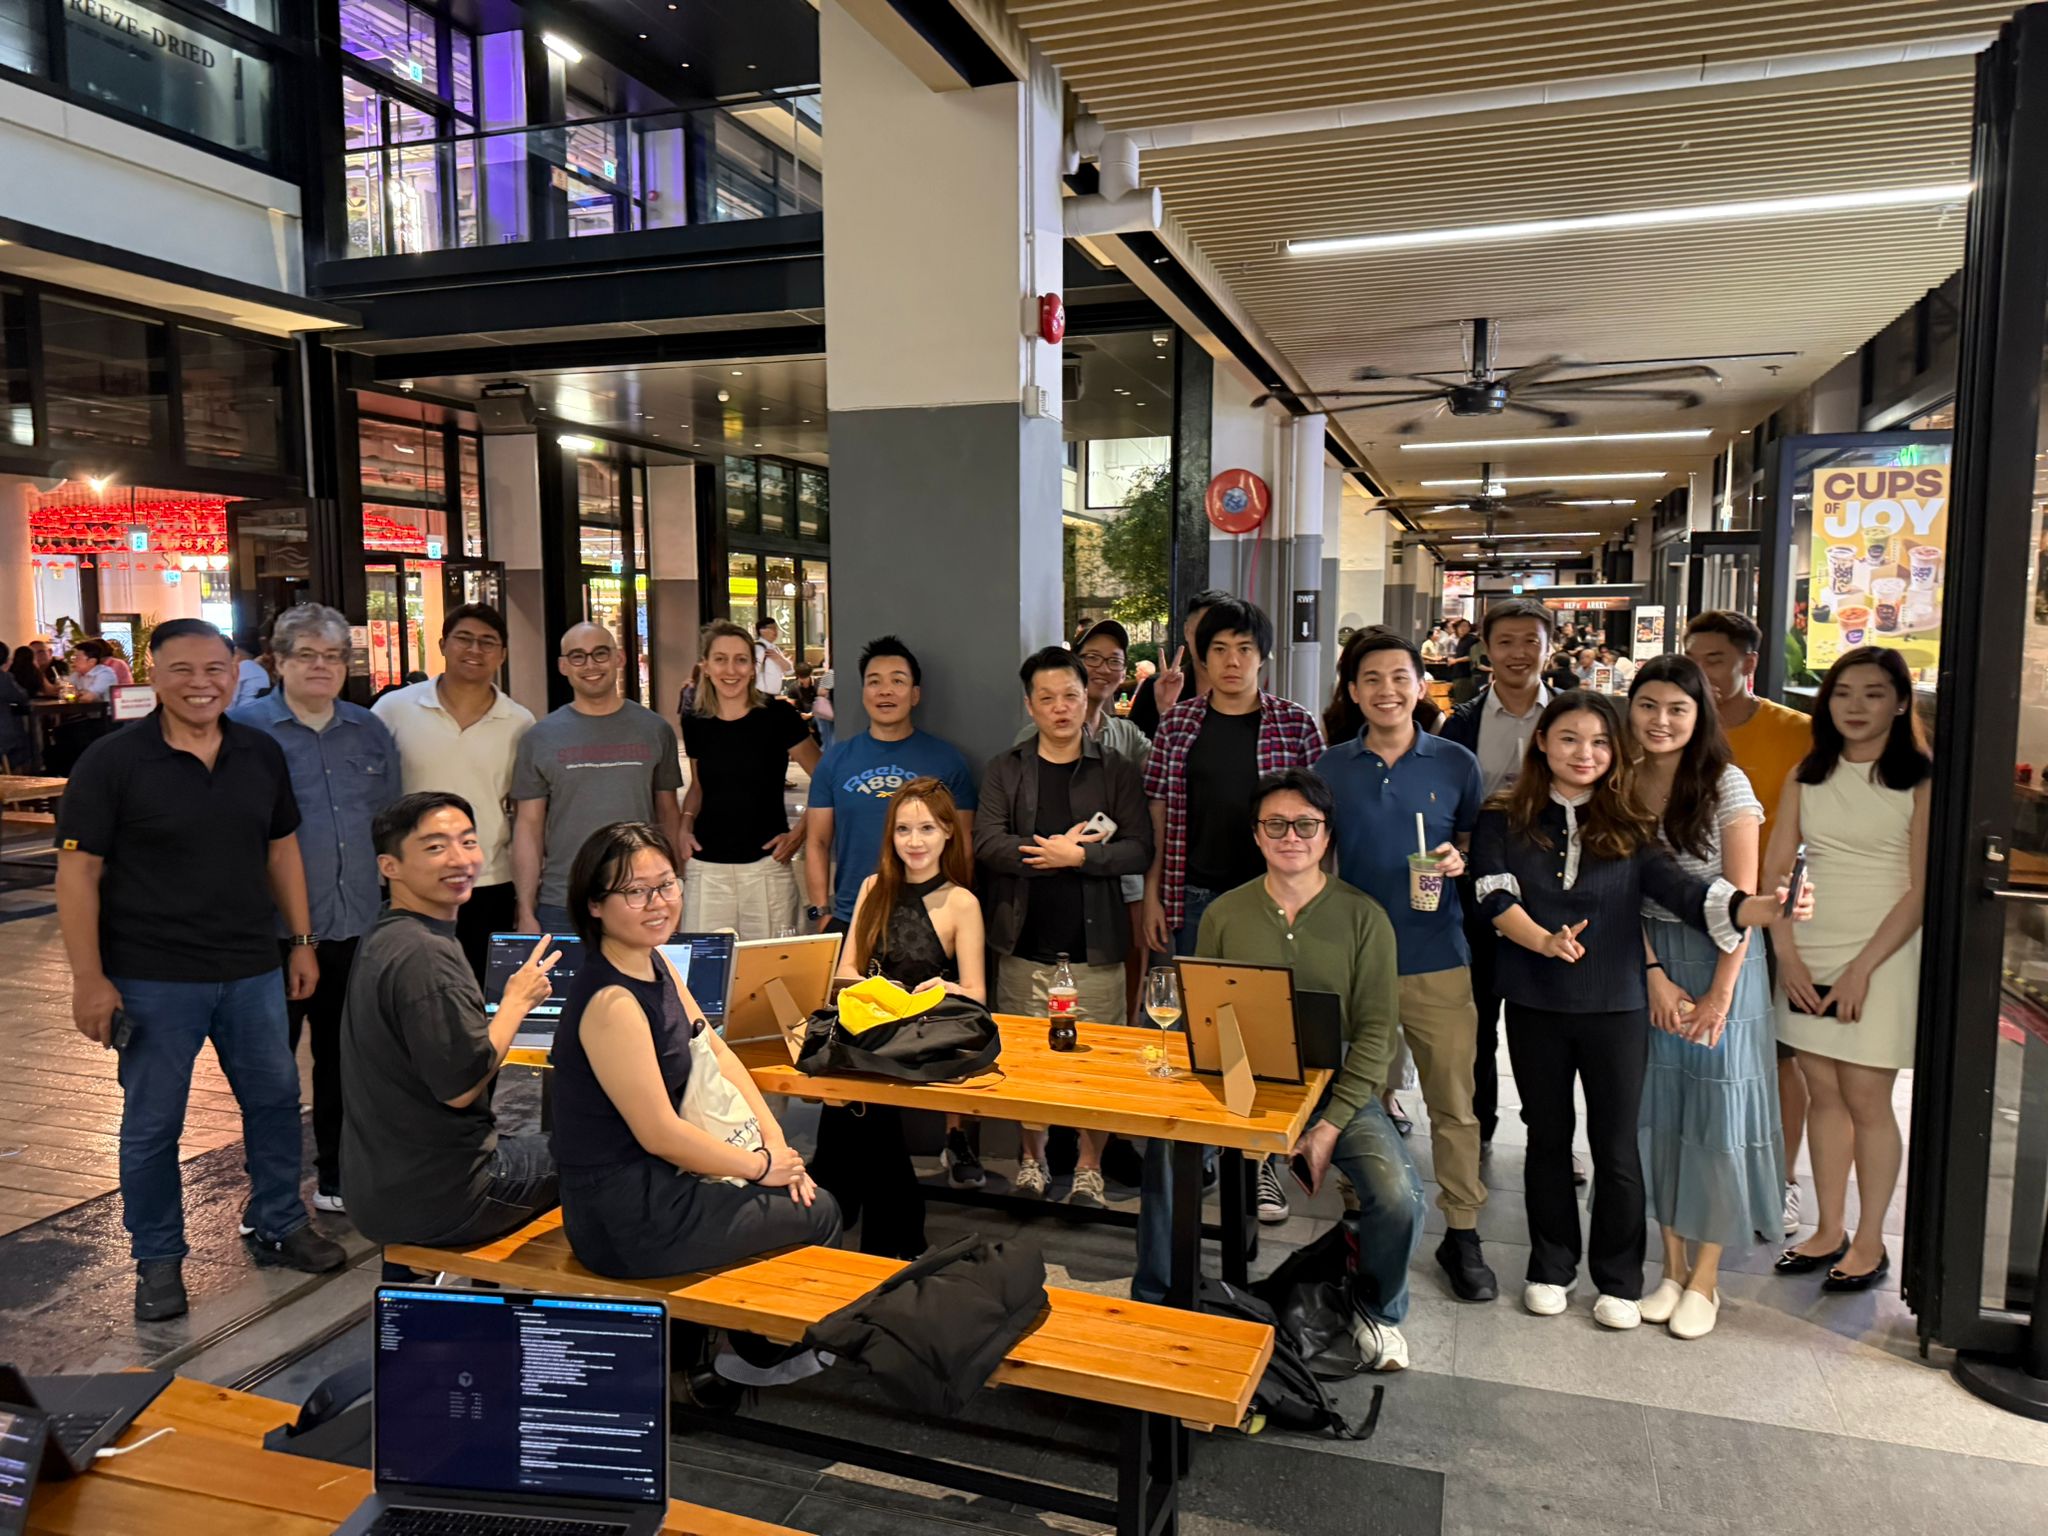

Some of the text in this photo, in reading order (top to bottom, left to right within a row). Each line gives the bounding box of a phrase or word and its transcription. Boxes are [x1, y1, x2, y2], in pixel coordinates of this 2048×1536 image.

[1824, 469, 1943, 501] CUPS
[1824, 498, 1945, 538] OF JOY
[1296, 595, 1315, 604] RWP
[843, 765, 919, 793] Reebo
[857, 776, 903, 794] 189
